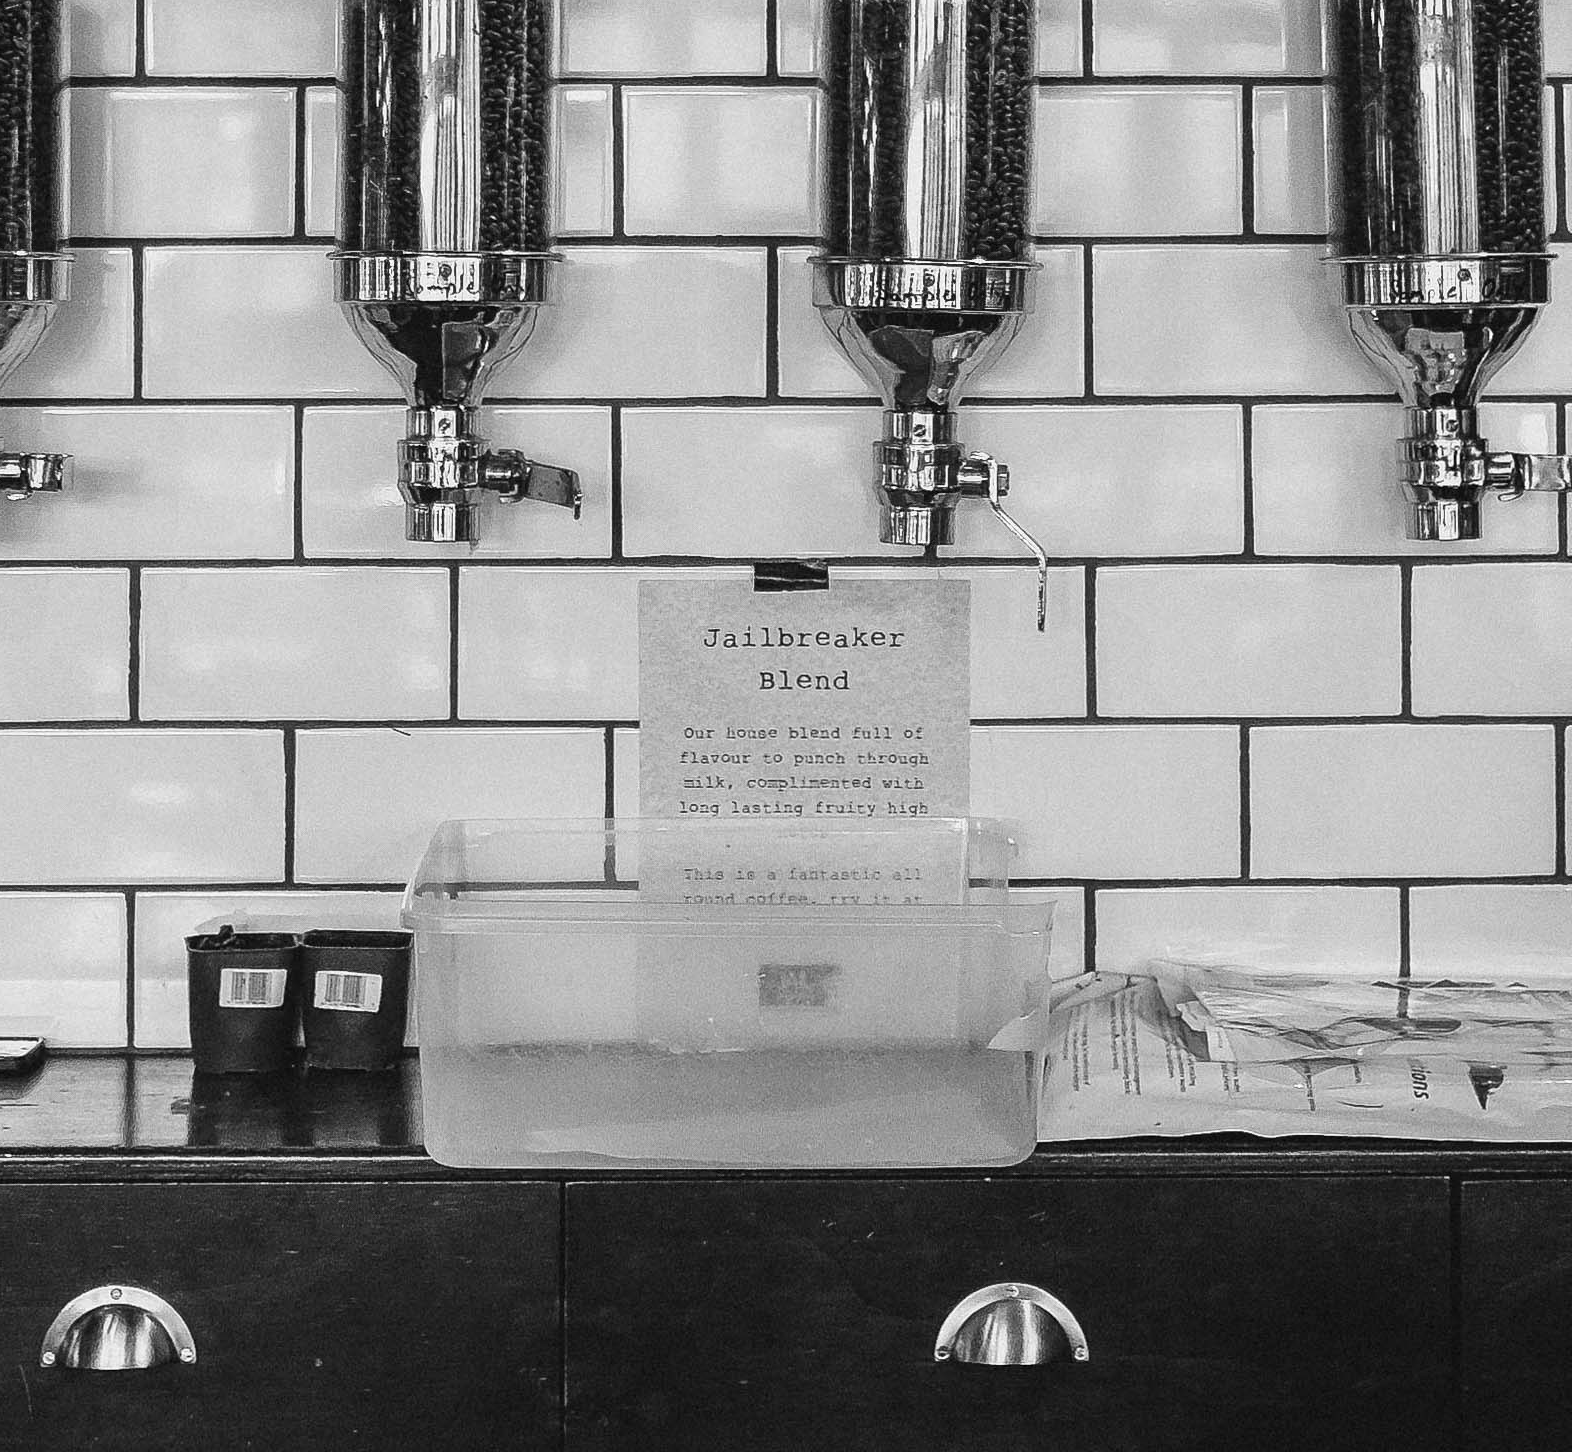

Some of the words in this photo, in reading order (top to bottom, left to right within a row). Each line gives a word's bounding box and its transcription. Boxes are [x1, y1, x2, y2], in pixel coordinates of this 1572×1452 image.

[703, 625, 905, 649] Jailbreaker
[759, 669, 850, 691] Blend
[683, 726, 715, 740] Our
[725, 726, 778, 740] house
[788, 726, 841, 740] blend
[852, 726, 892, 740] full
[903, 726, 924, 740] of
[679, 750, 752, 765] flavour
[762, 753, 784, 765] to
[793, 752, 846, 768] punch
[856, 751, 930, 768] through
[683, 775, 733, 791] milk,
[746, 775, 872, 793] complimented
[881, 776, 925, 790] with
[679, 800, 720, 818] long
[731, 800, 804, 818] lasting
[815, 800, 876, 818] fruity
[887, 801, 929, 819] high
[683, 867, 725, 881] This
[734, 869, 756, 881] is
[766, 870, 777, 881] a
[787, 866, 881, 882] fantastic
[891, 867, 923, 882] all
